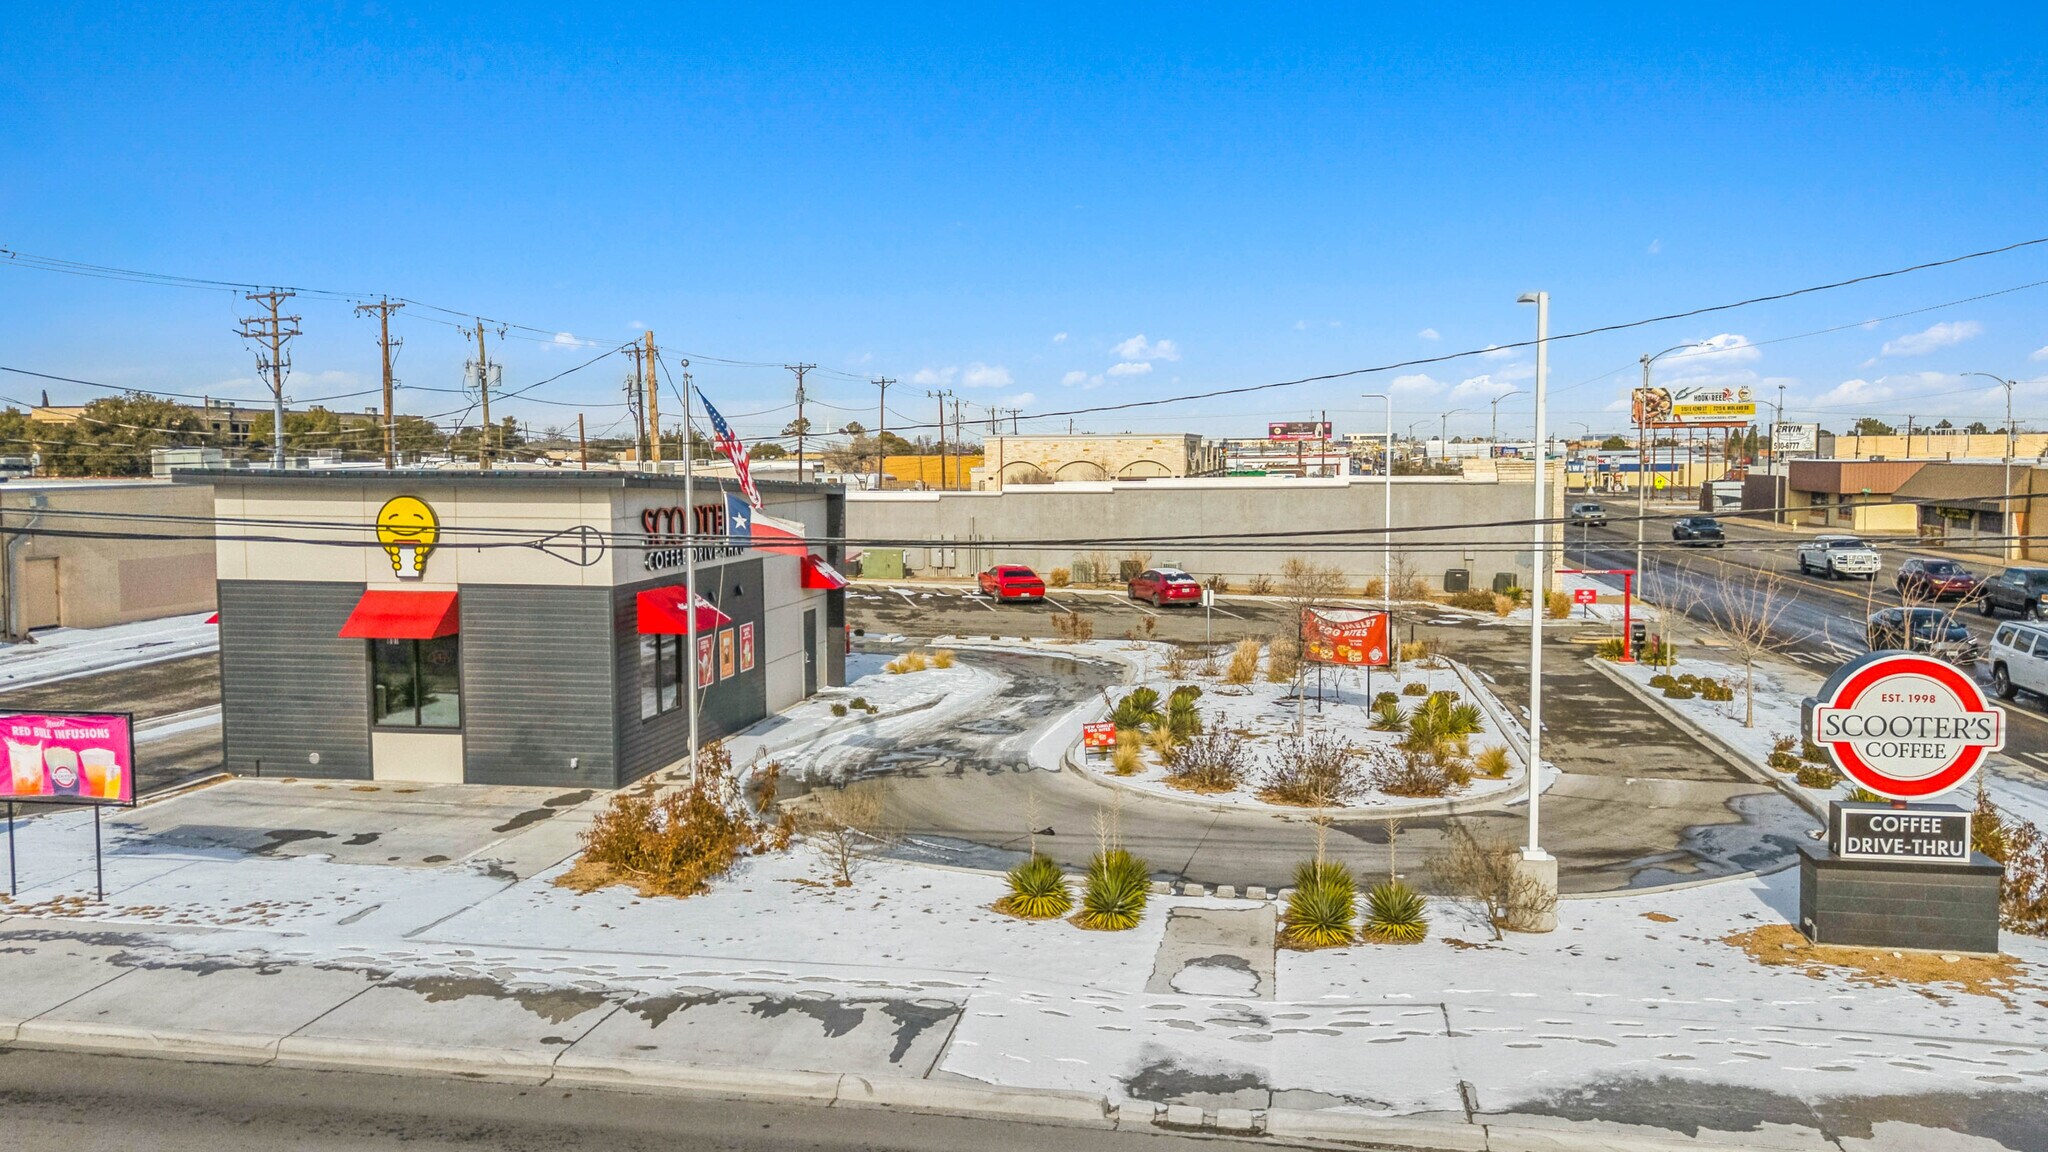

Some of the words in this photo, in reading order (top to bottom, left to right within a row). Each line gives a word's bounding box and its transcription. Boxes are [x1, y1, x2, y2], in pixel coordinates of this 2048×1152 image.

[1775, 425, 1802, 433] ERVIN
[641, 504, 725, 545] SCOOTE
[645, 548, 687, 571] COFFEE
[1318, 626, 1341, 637] EGG
[1343, 628, 1368, 637] BITES
[1881, 693, 1905, 703] EST.
[1908, 694, 1937, 704] 1998
[12, 726, 31, 736] RED
[33, 727, 52, 739] BULL
[54, 728, 110, 739] INFUSIONS
[1825, 714, 1992, 741] SCOOTER'S
[1865, 741, 1947, 760] COFFEE
[1869, 816, 1942, 834] COFFEE
[1847, 838, 1964, 857] DRIVE-THRU
